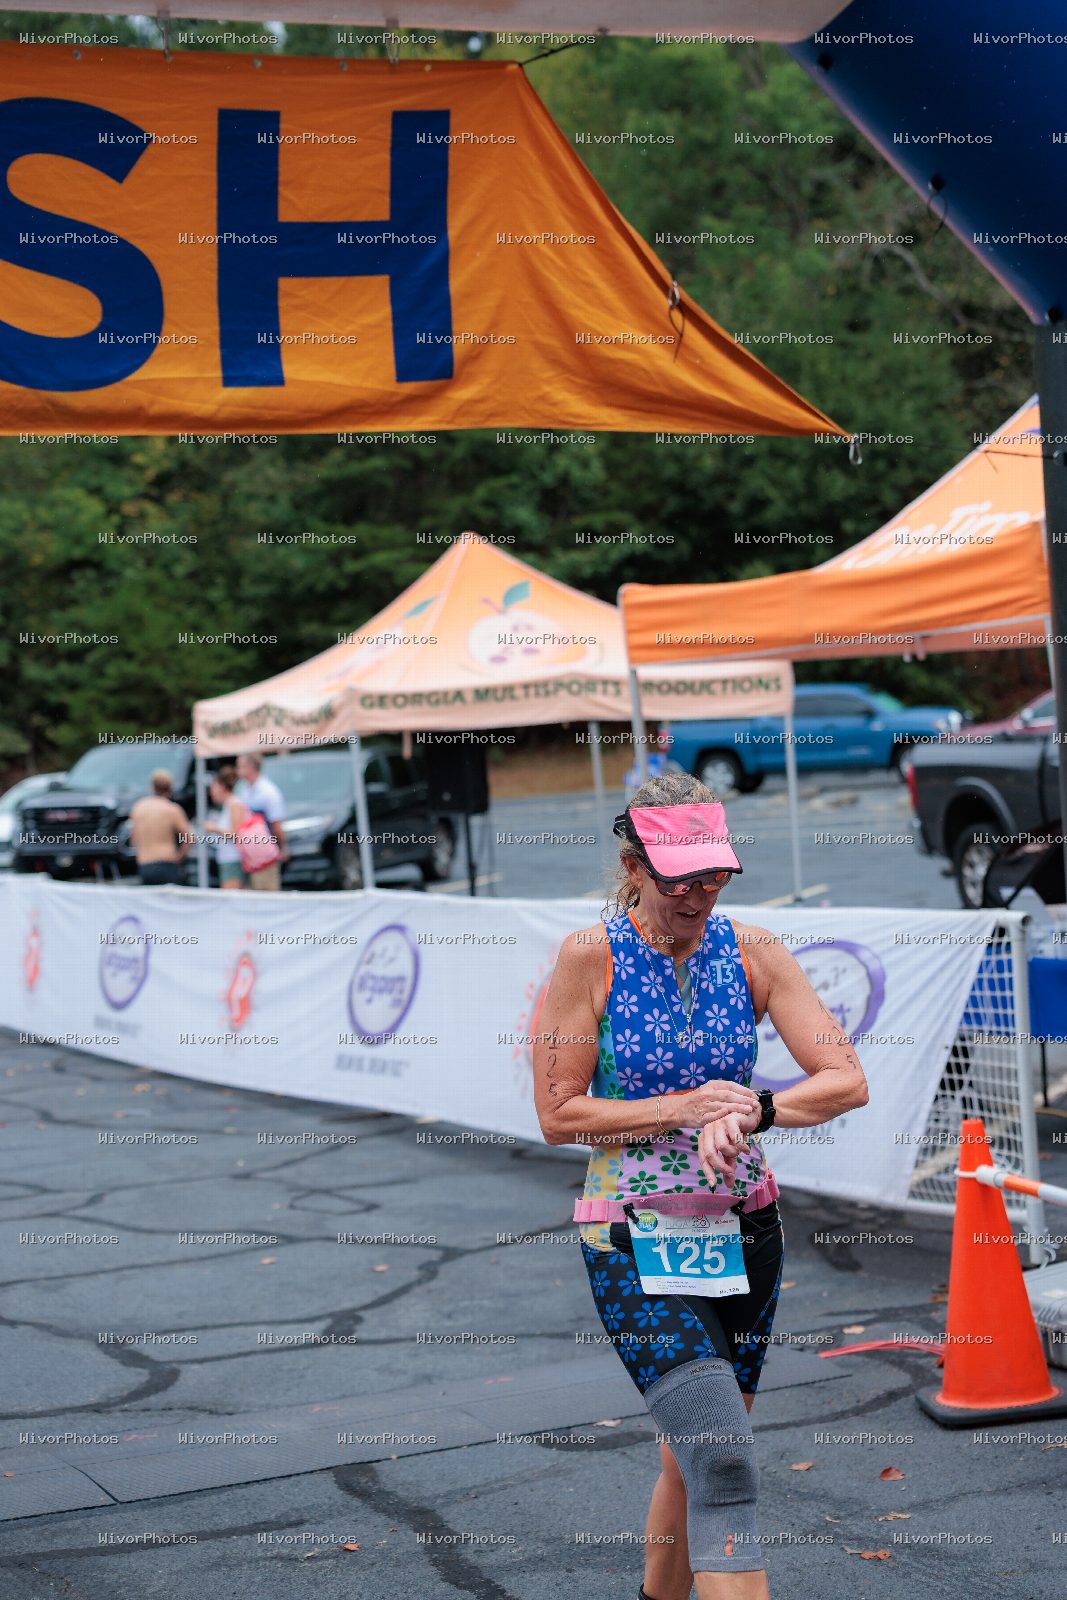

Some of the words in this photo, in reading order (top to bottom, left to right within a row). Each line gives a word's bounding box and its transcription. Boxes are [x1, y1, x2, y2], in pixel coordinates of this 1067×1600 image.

[360, 690, 467, 710] GEORGIA
[472, 679, 622, 703] MULTISPORTS
[636, 676, 783, 697] RODUCTIONS
[710, 957, 734, 985] T3
[652, 1239, 726, 1275] 125
